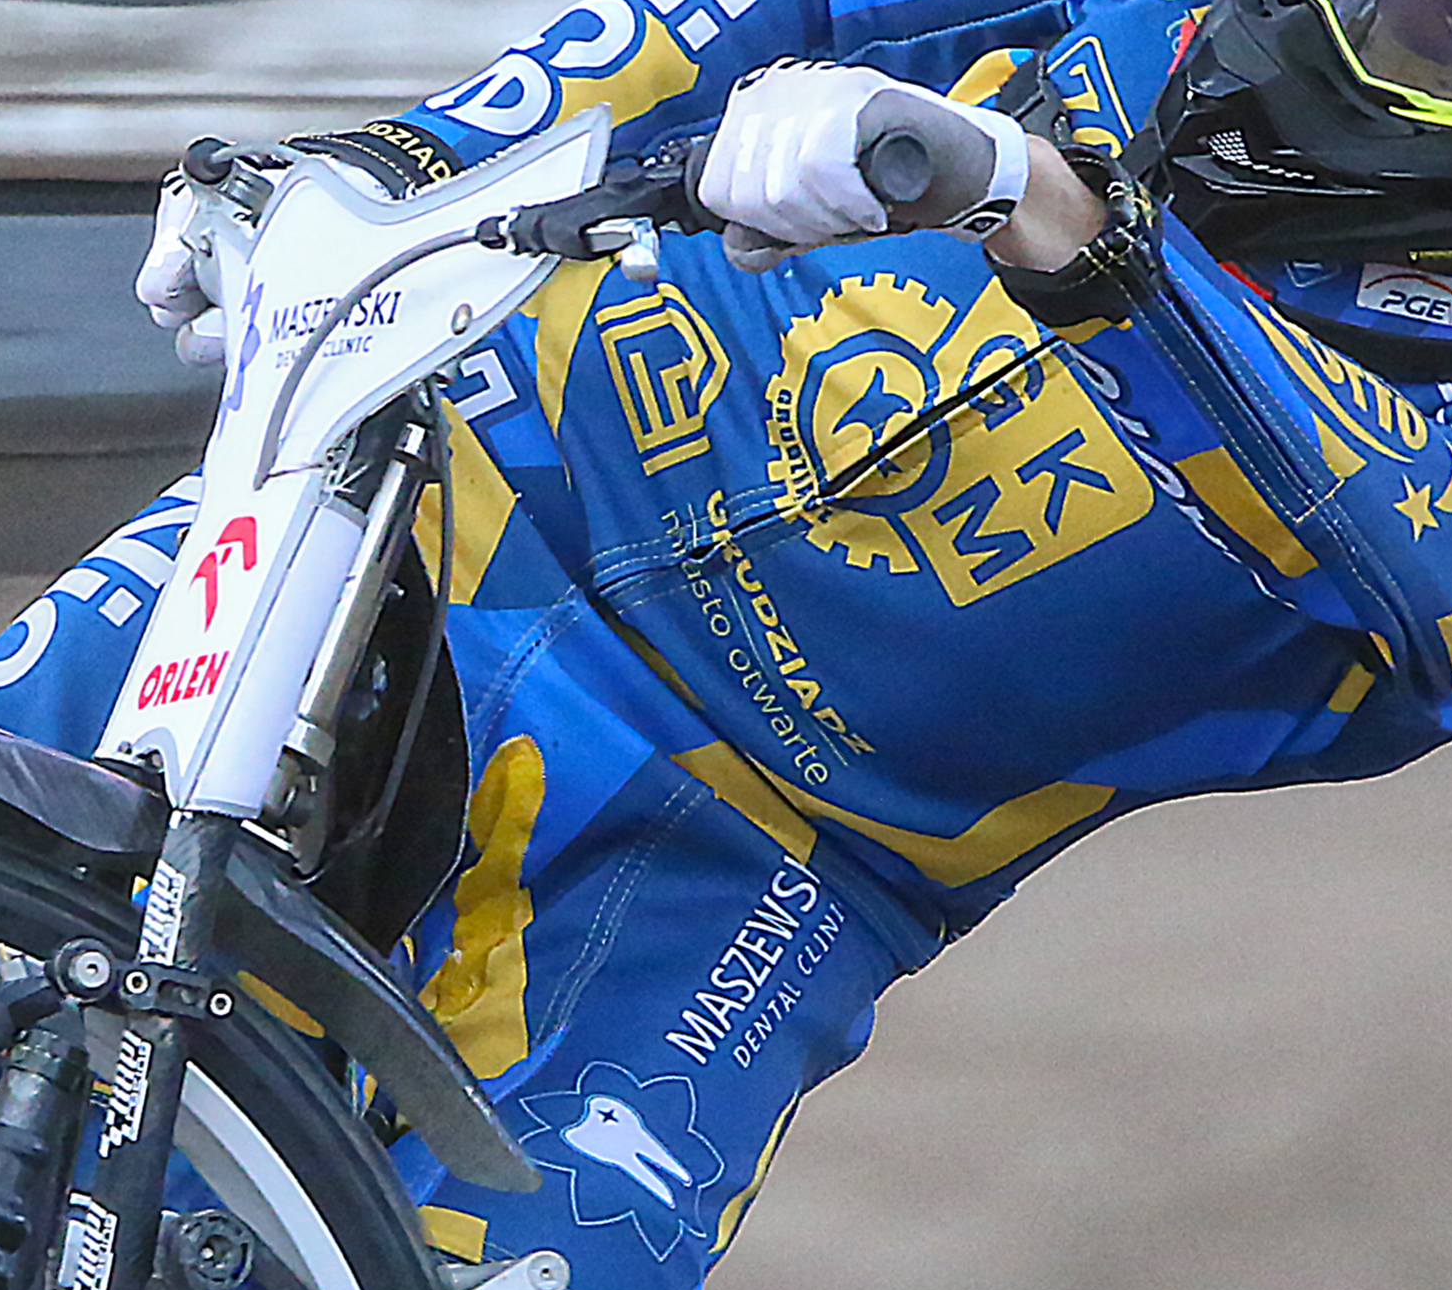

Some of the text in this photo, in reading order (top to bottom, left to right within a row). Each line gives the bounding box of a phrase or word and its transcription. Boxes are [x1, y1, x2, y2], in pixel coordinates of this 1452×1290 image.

[1380, 289, 1451, 321] PGE
[137, 650, 230, 710] ORLEN
[728, 648, 829, 787] otwarte
[732, 904, 847, 1069] DENTAL CLINI
